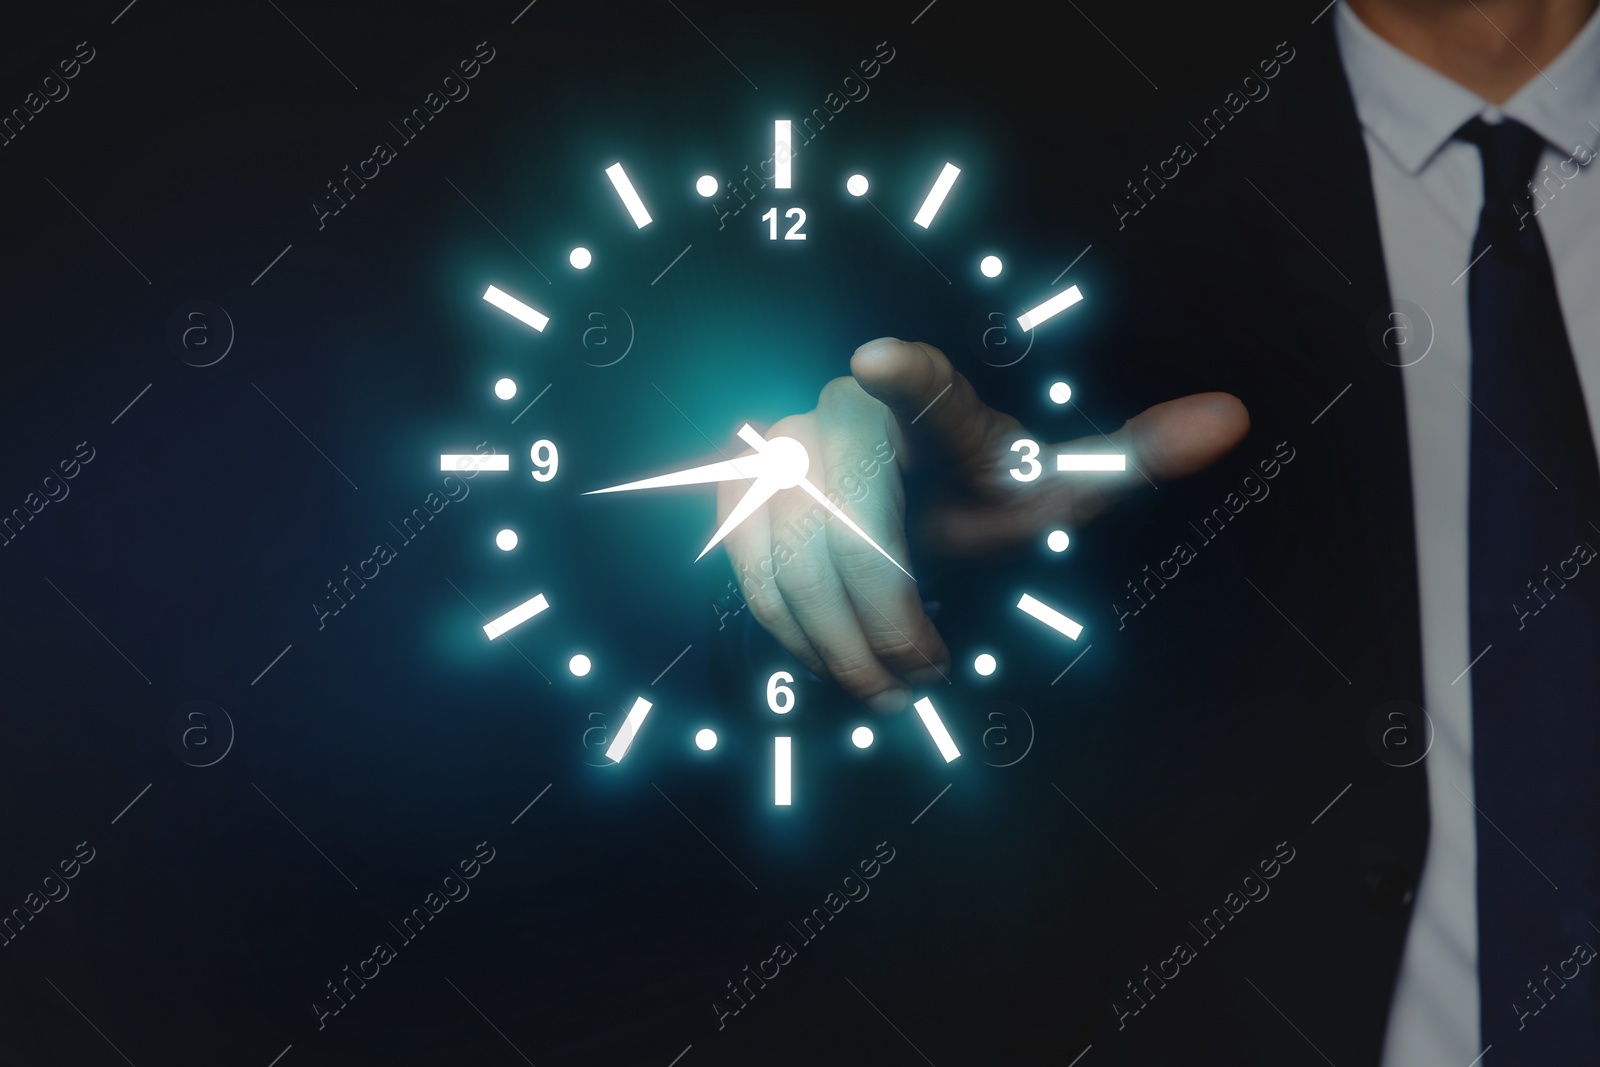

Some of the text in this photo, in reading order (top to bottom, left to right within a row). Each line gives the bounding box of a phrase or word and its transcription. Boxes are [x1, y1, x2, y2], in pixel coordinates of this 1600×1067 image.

[762, 207, 807, 240] 12
[530, 439, 559, 482] 9
[1009, 439, 1042, 482] 3
[766, 671, 795, 714] 6
